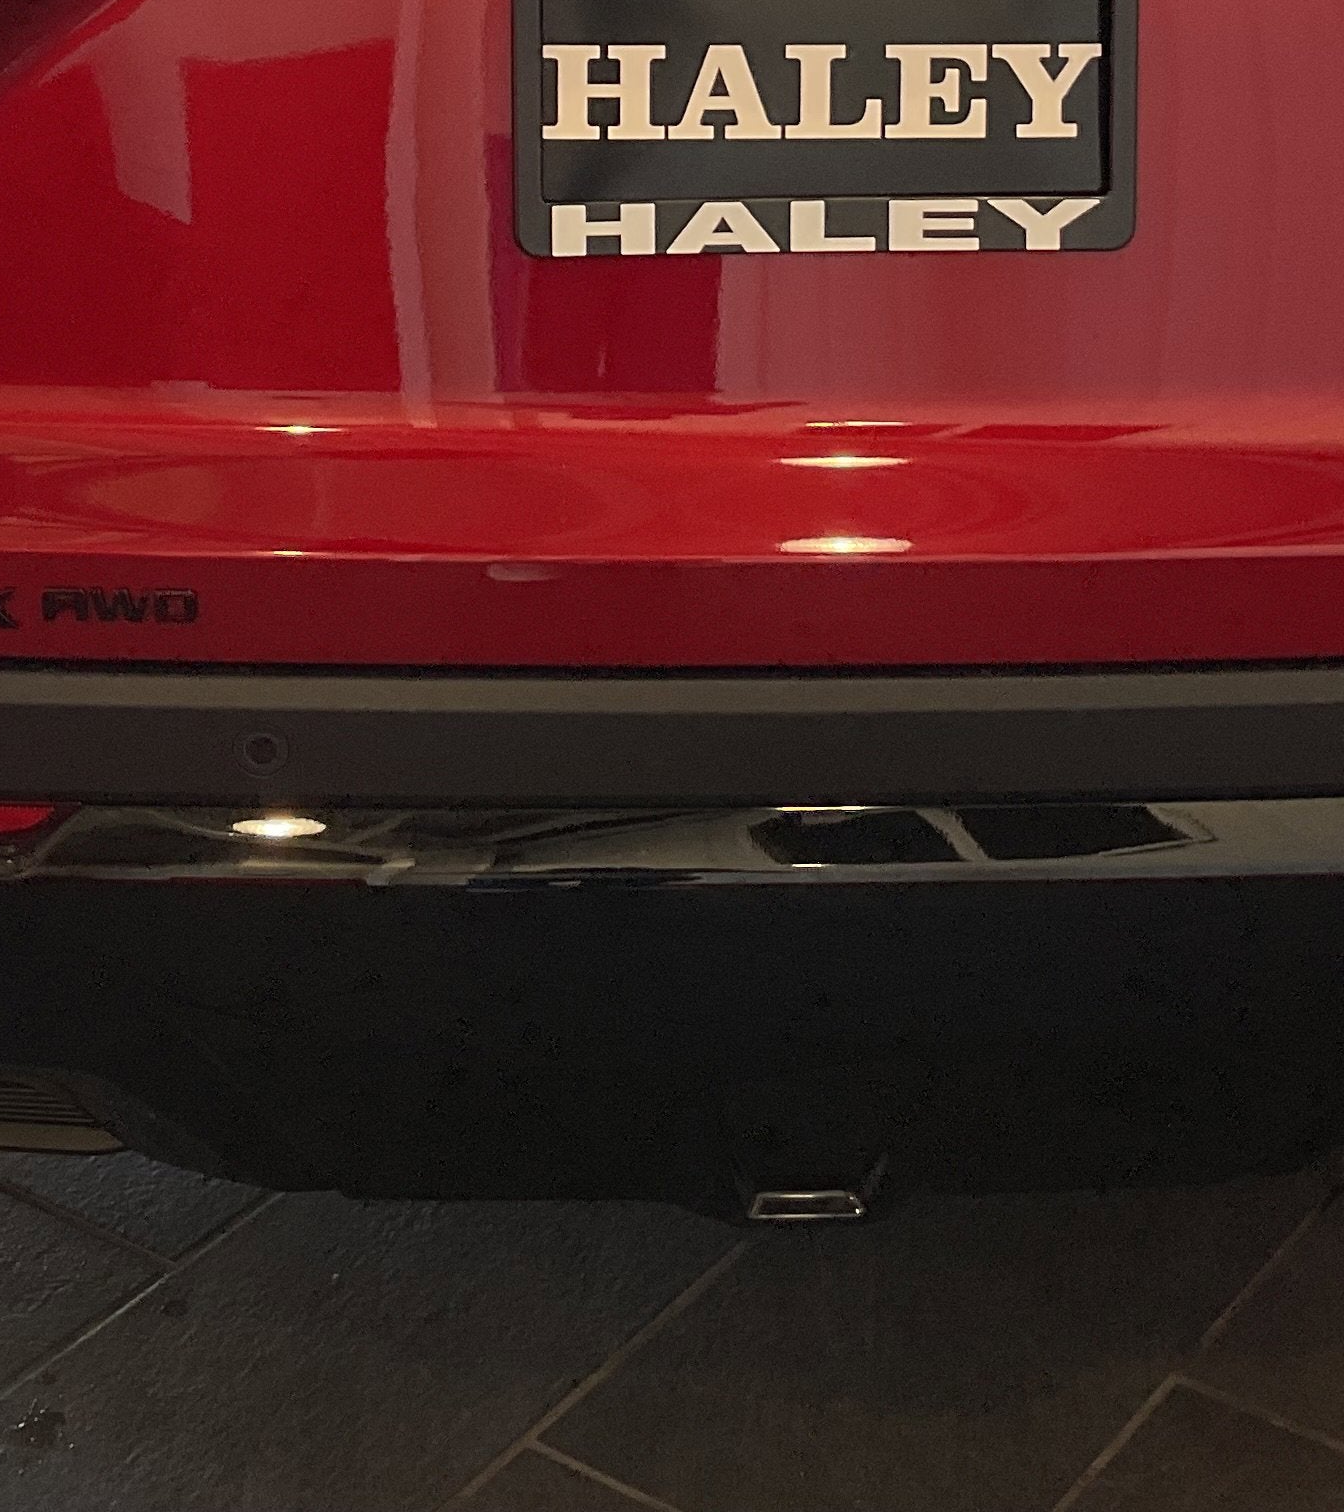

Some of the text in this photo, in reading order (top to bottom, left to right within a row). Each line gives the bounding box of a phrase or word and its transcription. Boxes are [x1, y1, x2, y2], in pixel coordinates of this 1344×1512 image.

[542, 43, 1103, 140] HALEY
[550, 197, 1101, 257] HALEY
[41, 585, 199, 625] AWD
